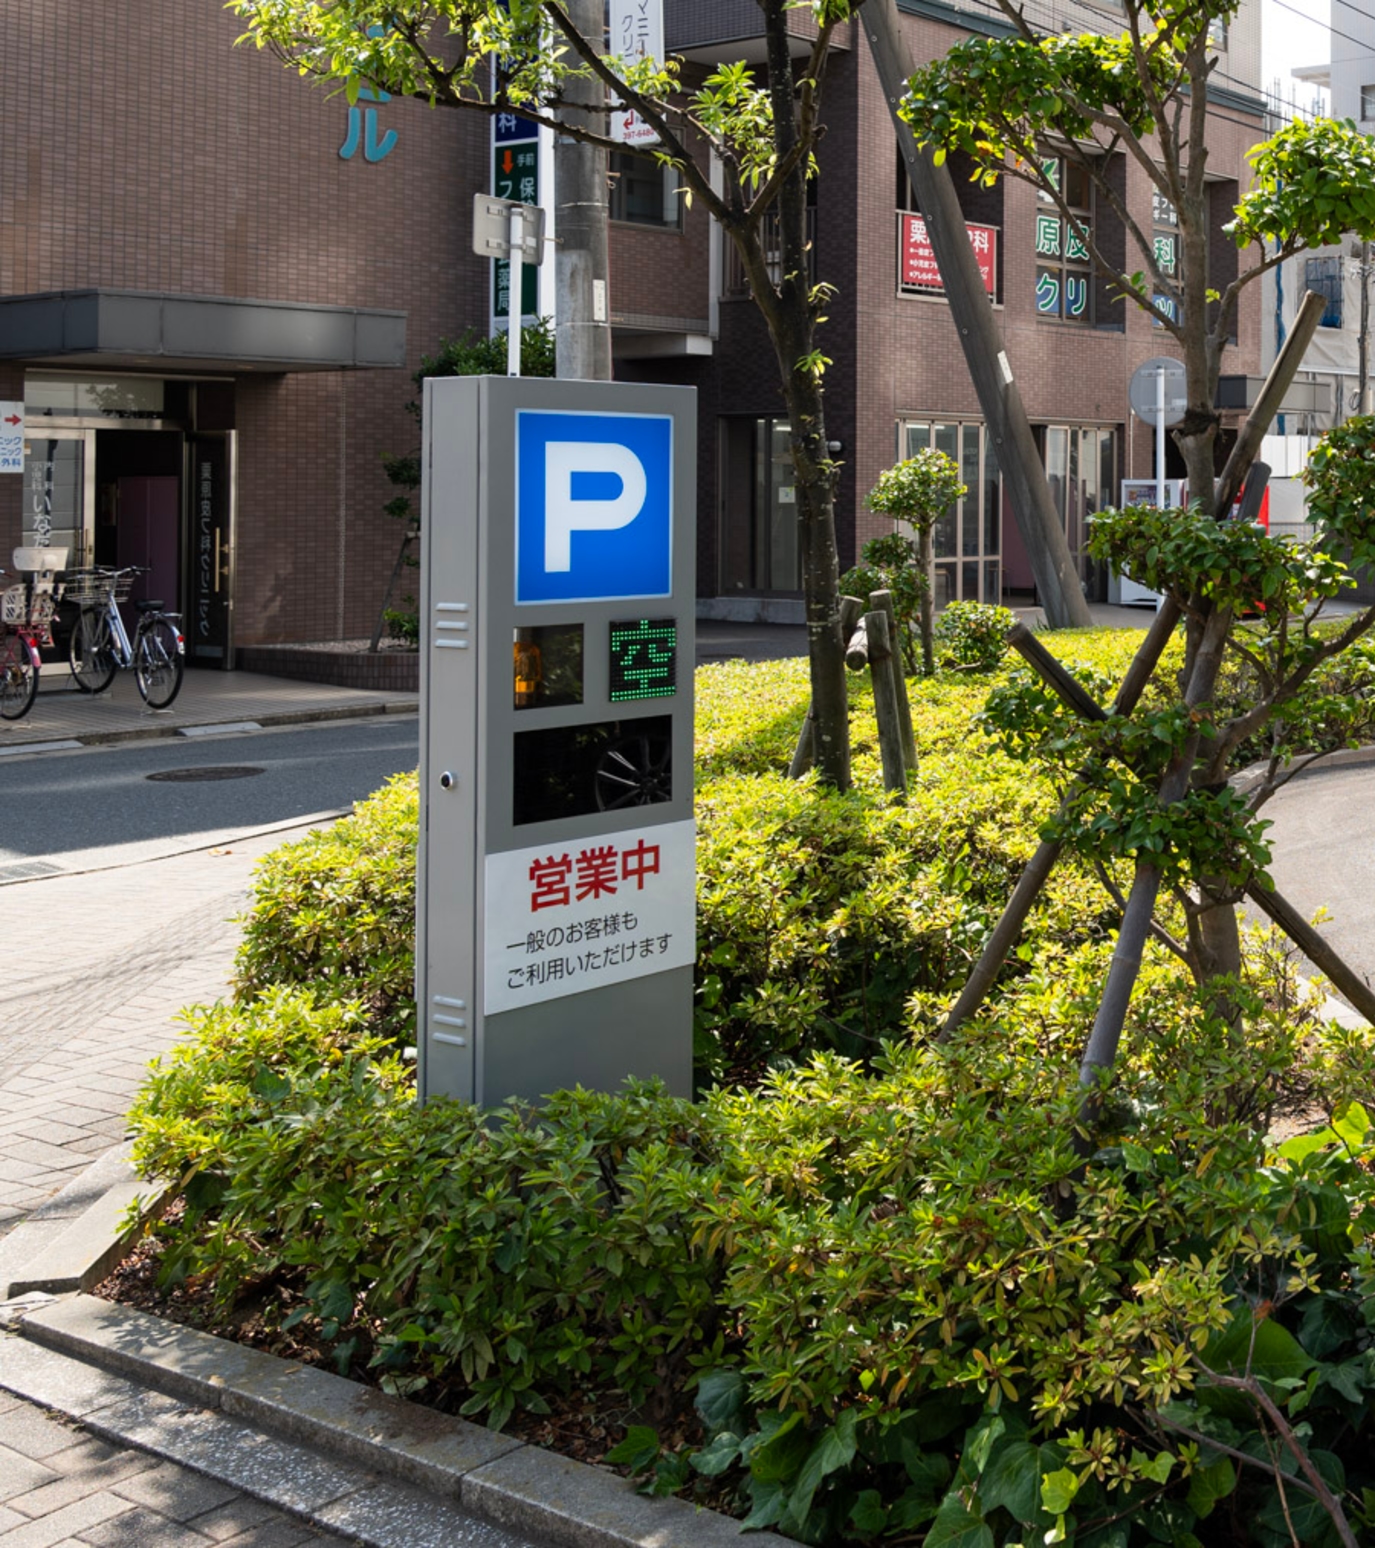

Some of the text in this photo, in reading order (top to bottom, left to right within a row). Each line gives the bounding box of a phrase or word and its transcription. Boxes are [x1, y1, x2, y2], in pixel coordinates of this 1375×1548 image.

[621, 14, 634, 57] クリ
[1, 458, 21, 467] 外科
[544, 441, 647, 573] P
[611, 619, 677, 702] 空
[529, 838, 661, 913] 営業中
[506, 910, 639, 955] 一般のお客様も
[507, 932, 673, 990] ご利用いただけます
